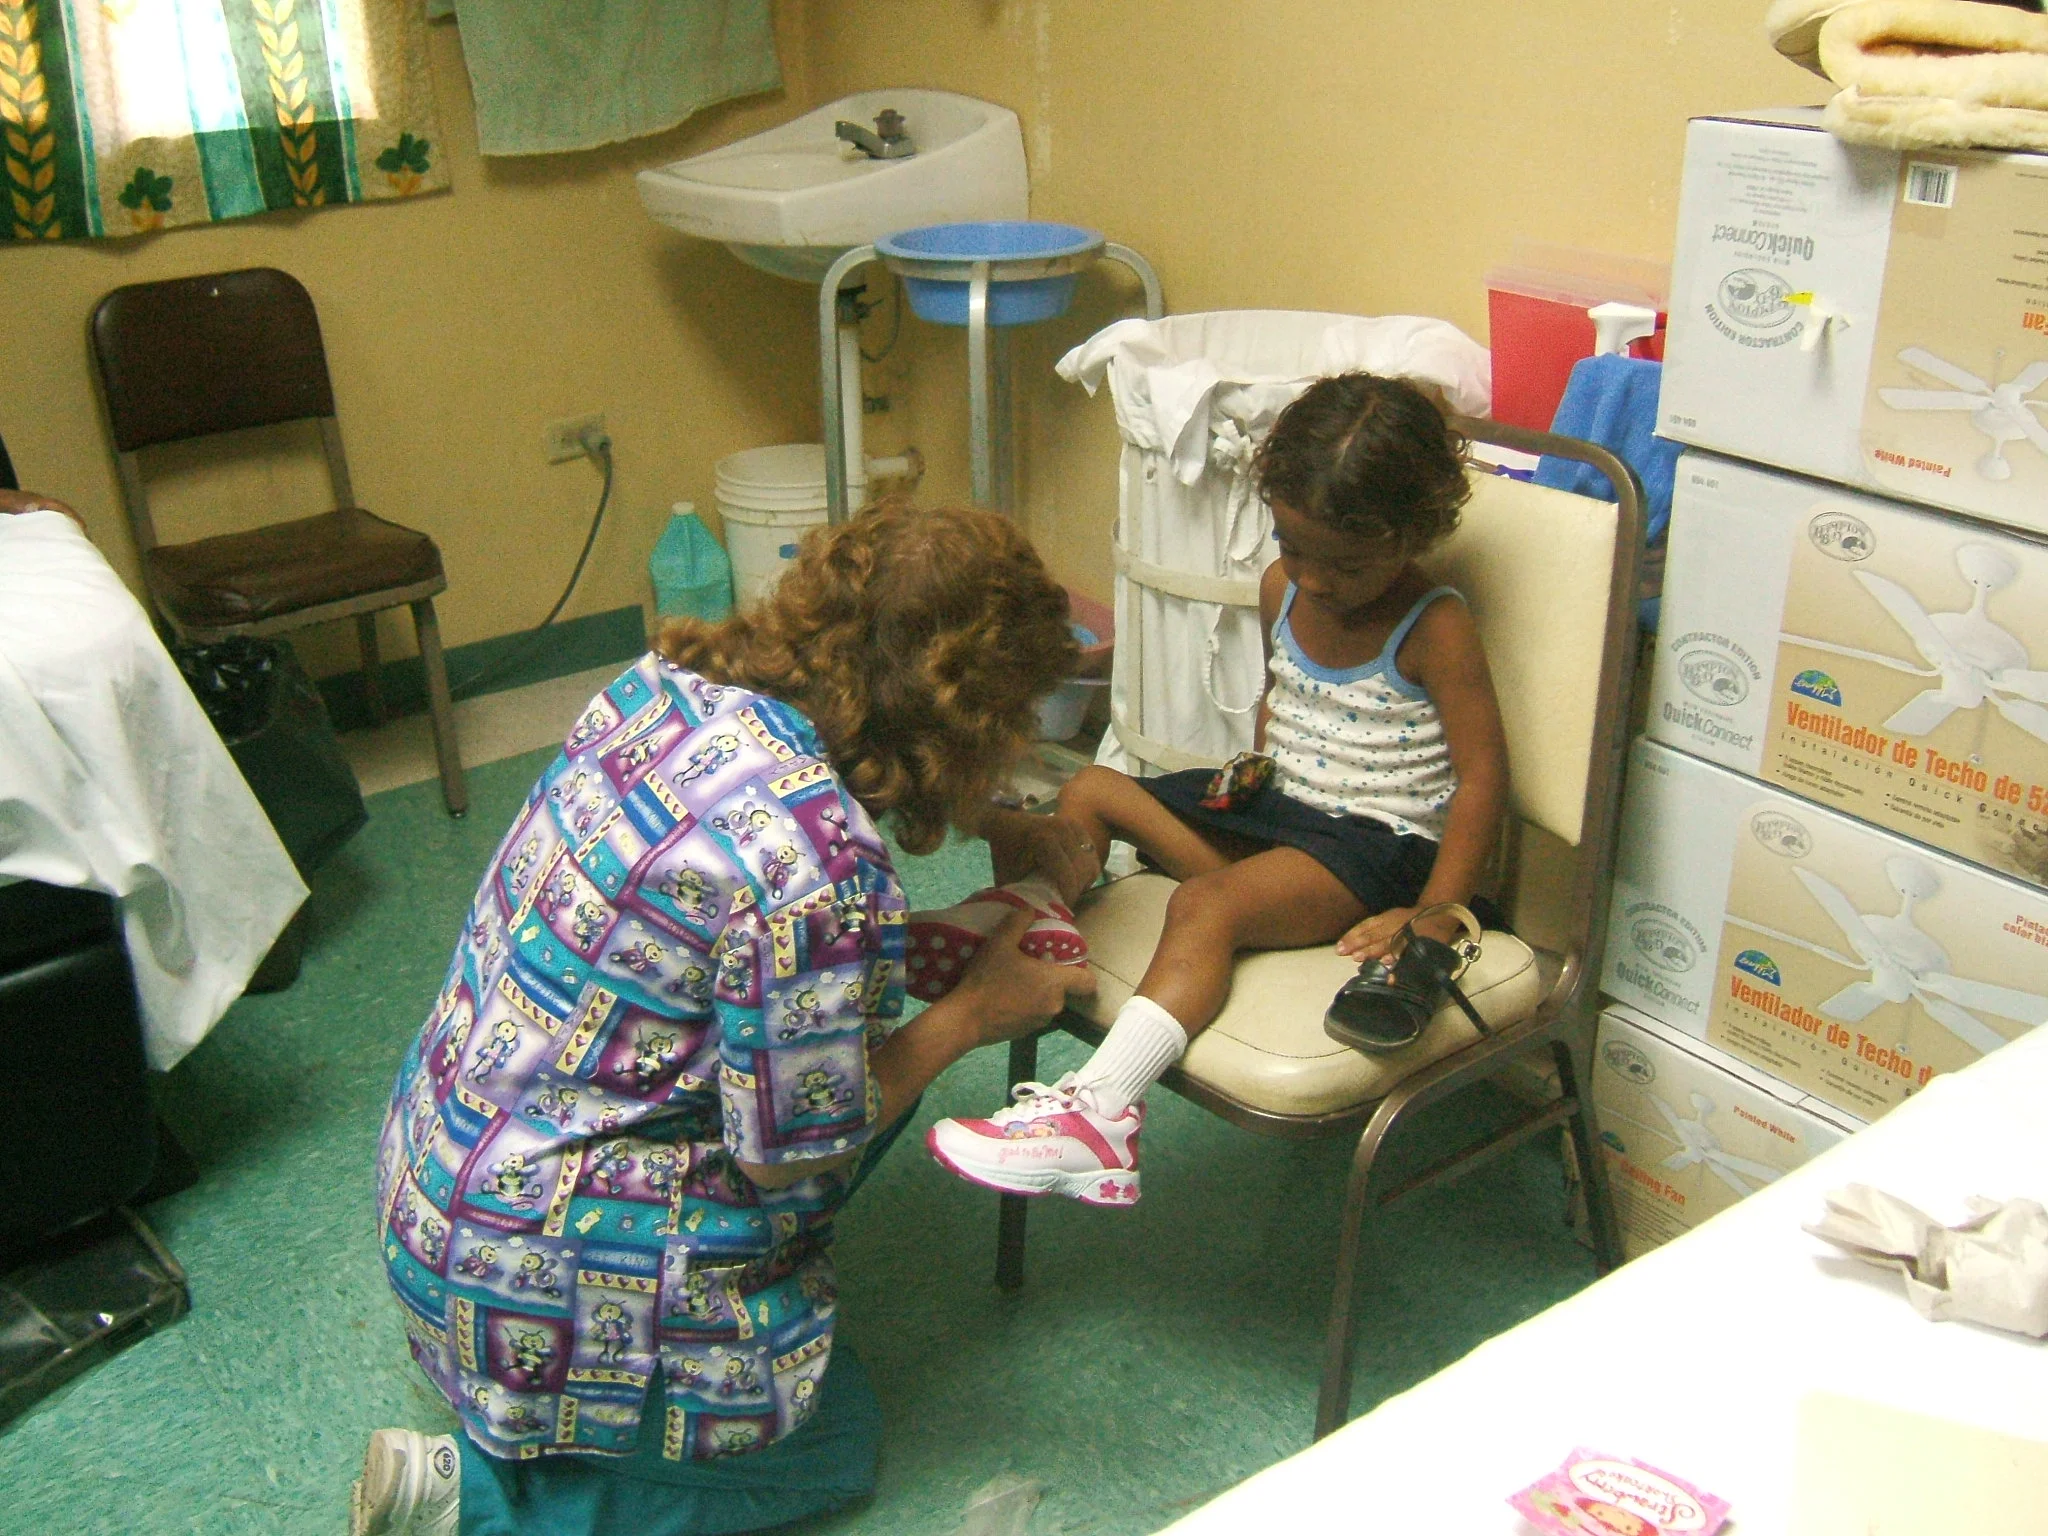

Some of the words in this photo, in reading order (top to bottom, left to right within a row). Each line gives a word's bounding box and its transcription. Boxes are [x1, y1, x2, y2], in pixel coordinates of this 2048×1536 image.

[1874, 449, 1906, 468] White
[1906, 458, 1952, 478] Painted
[1786, 701, 1888, 757] Ventilador
[1891, 739, 1919, 769] de
[1924, 748, 1988, 793] Techo
[1994, 774, 2022, 805] de
[1730, 975, 1823, 1036] Ventilador
[1826, 1022, 1851, 1049] de
[1856, 1033, 1913, 1079] Techo
[1664, 1185, 1686, 1207] Fan
